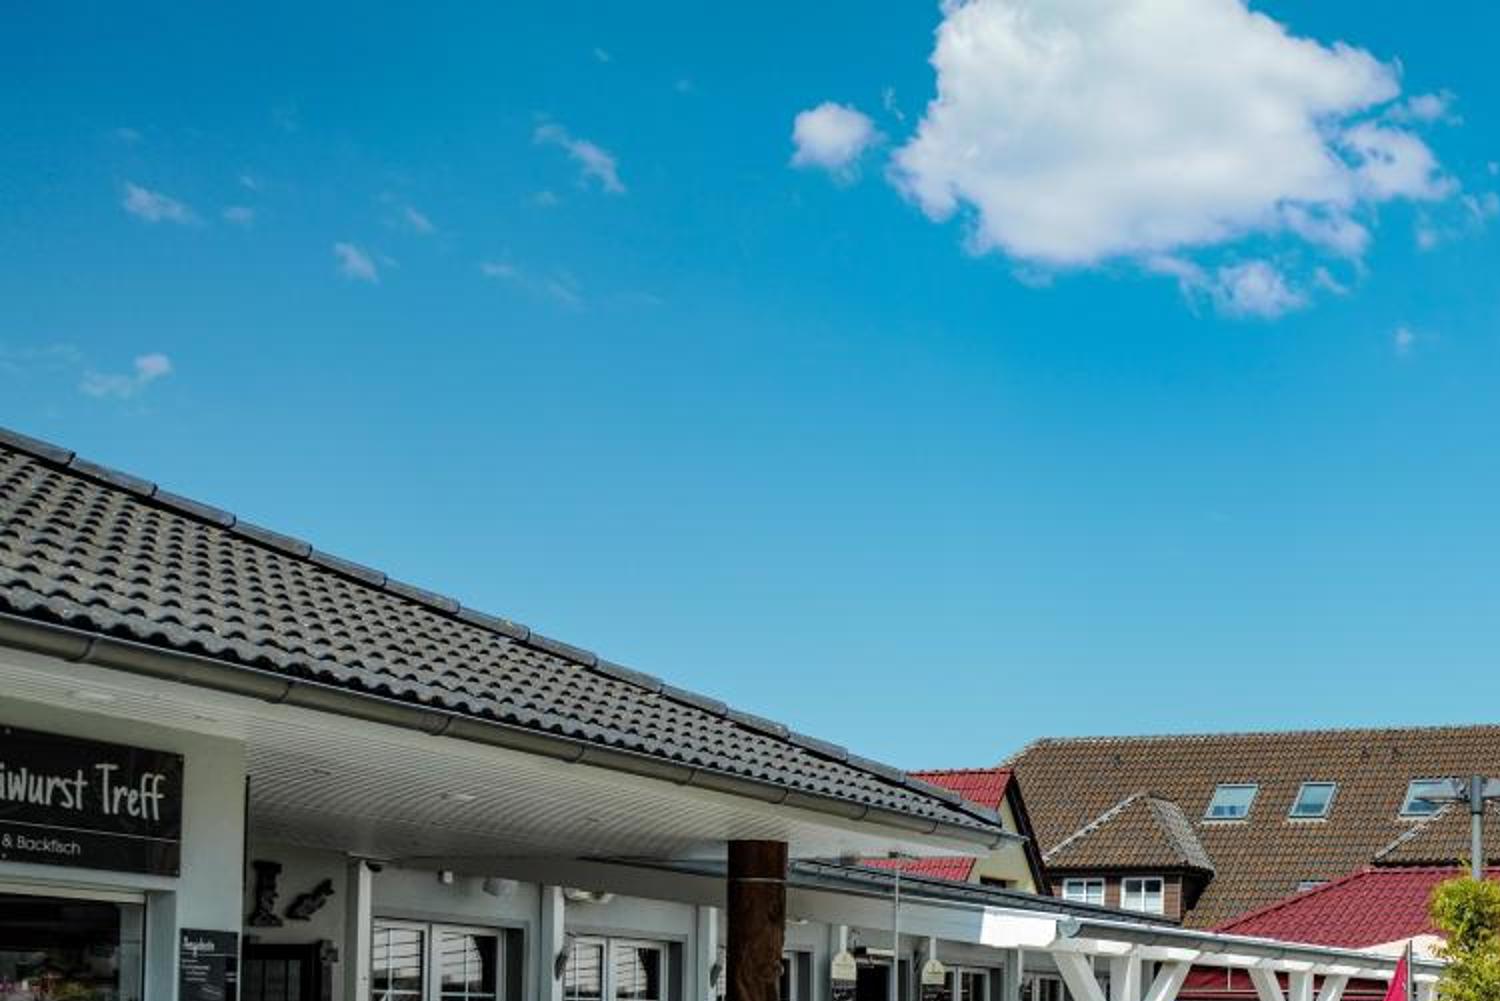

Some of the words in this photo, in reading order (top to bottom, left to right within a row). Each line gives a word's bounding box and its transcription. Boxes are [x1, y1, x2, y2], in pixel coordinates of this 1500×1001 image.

[95, 763, 166, 821] Treff
[1, 833, 13, 848] &
[17, 835, 81, 856] Backfisch
